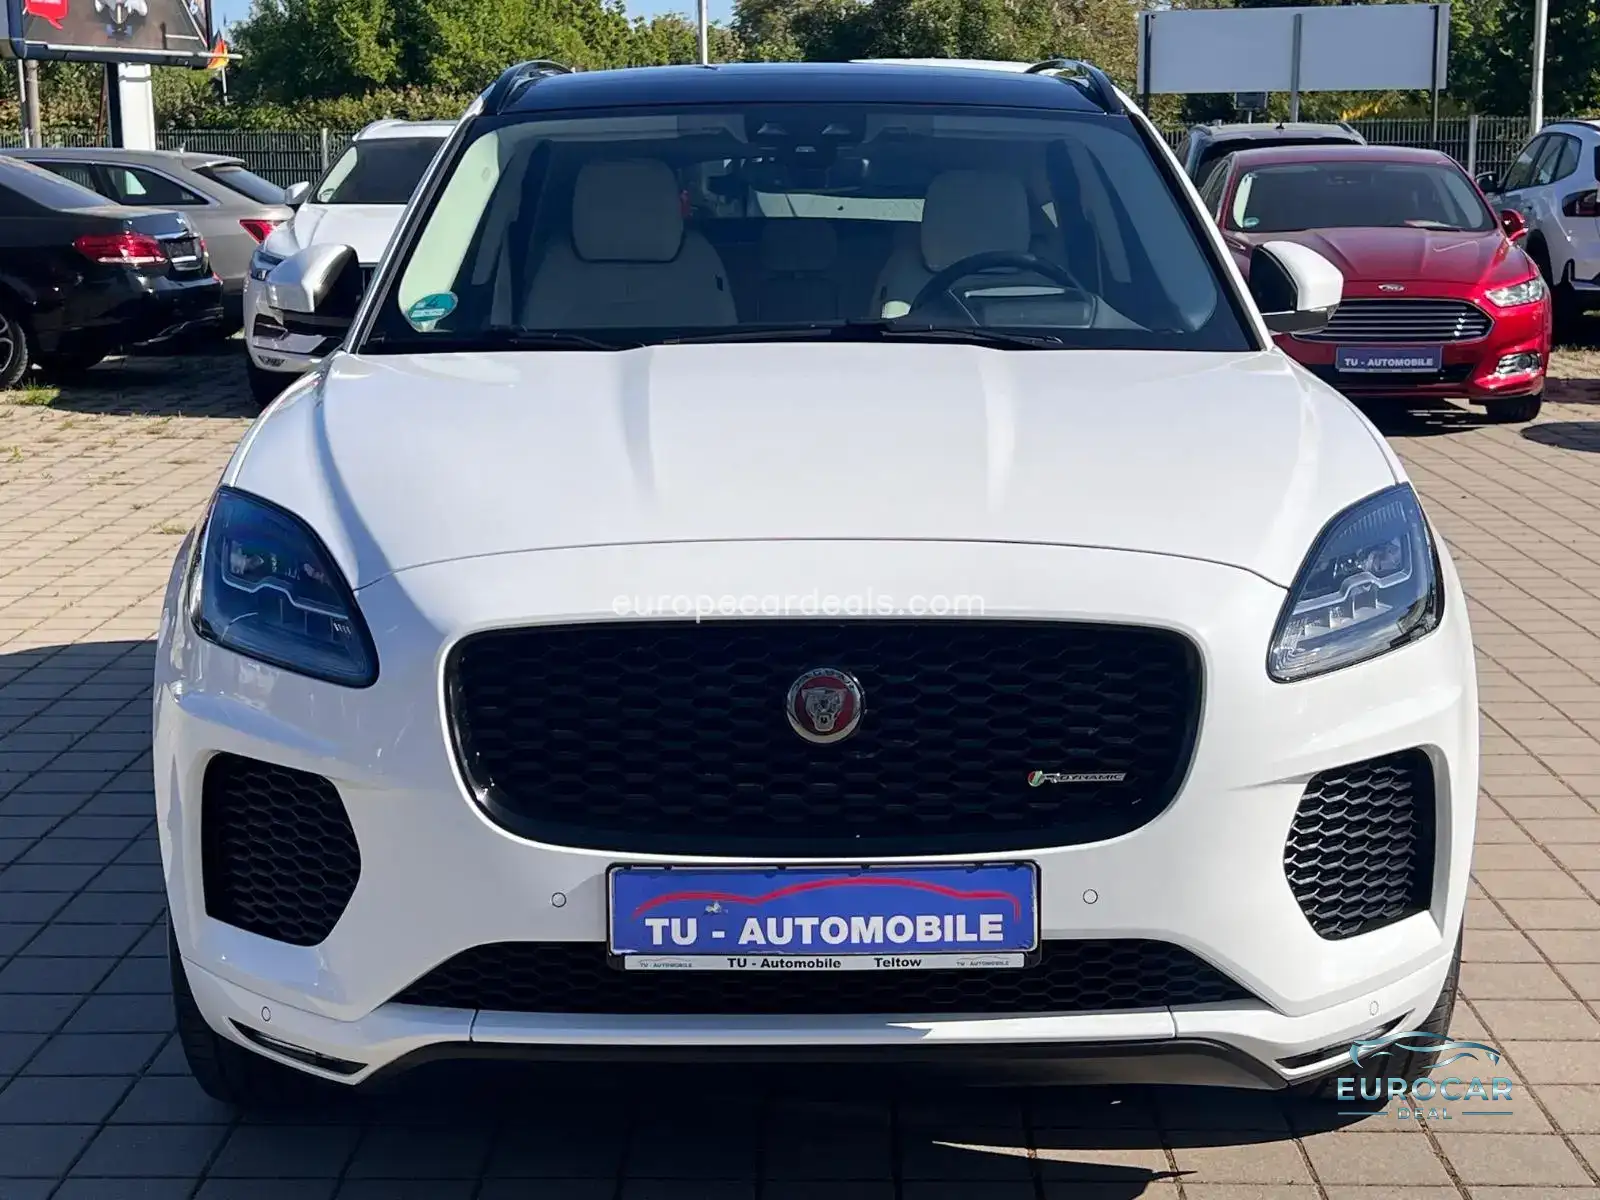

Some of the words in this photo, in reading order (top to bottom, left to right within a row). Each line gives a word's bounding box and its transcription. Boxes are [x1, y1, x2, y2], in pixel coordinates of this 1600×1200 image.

[1344, 358, 1358, 366] TU
[1367, 358, 1433, 367] AUTOMOBILE
[645, 918, 697, 945] TU
[711, 930, 725, 938] -
[738, 914, 1004, 945] AUTOMOBILE
[727, 958, 747, 968] TU
[760, 958, 842, 968] Automobile
[874, 957, 922, 968] Teltow
